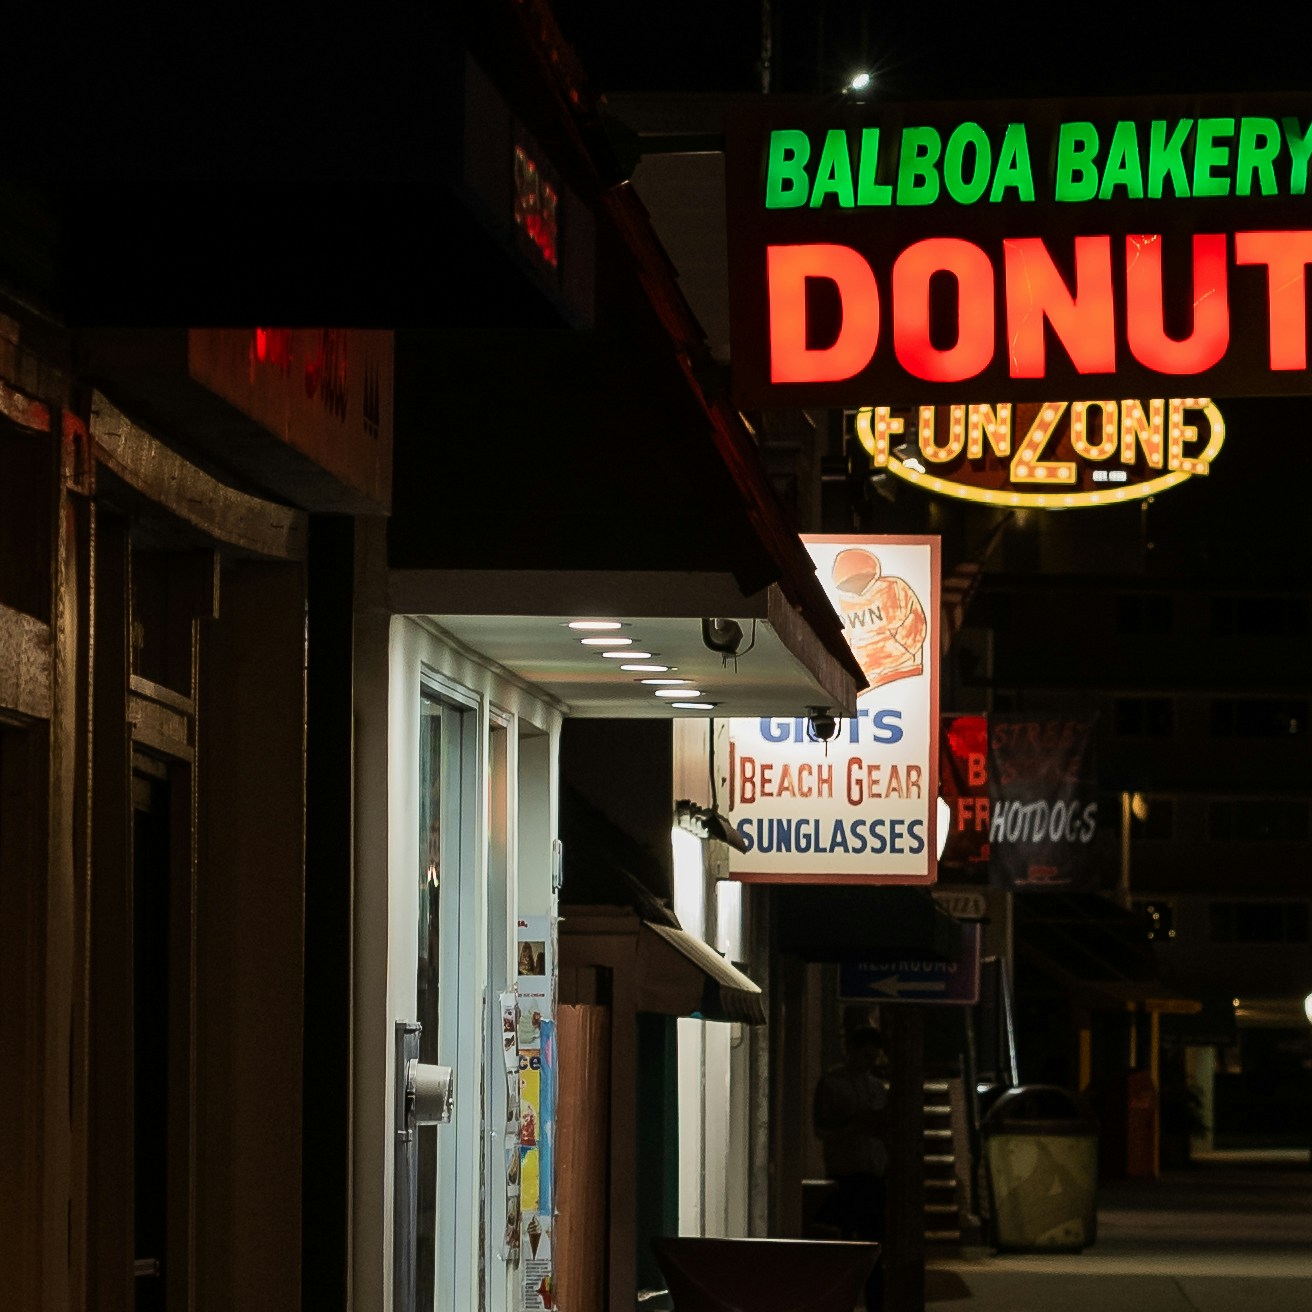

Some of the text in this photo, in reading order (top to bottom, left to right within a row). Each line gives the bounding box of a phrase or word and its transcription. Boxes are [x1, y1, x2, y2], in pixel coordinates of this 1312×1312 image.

[766, 121, 1037, 209] BALBOA
[739, 755, 922, 806] BEACH GEAR
[736, 818, 925, 855] SUNGLASSES
